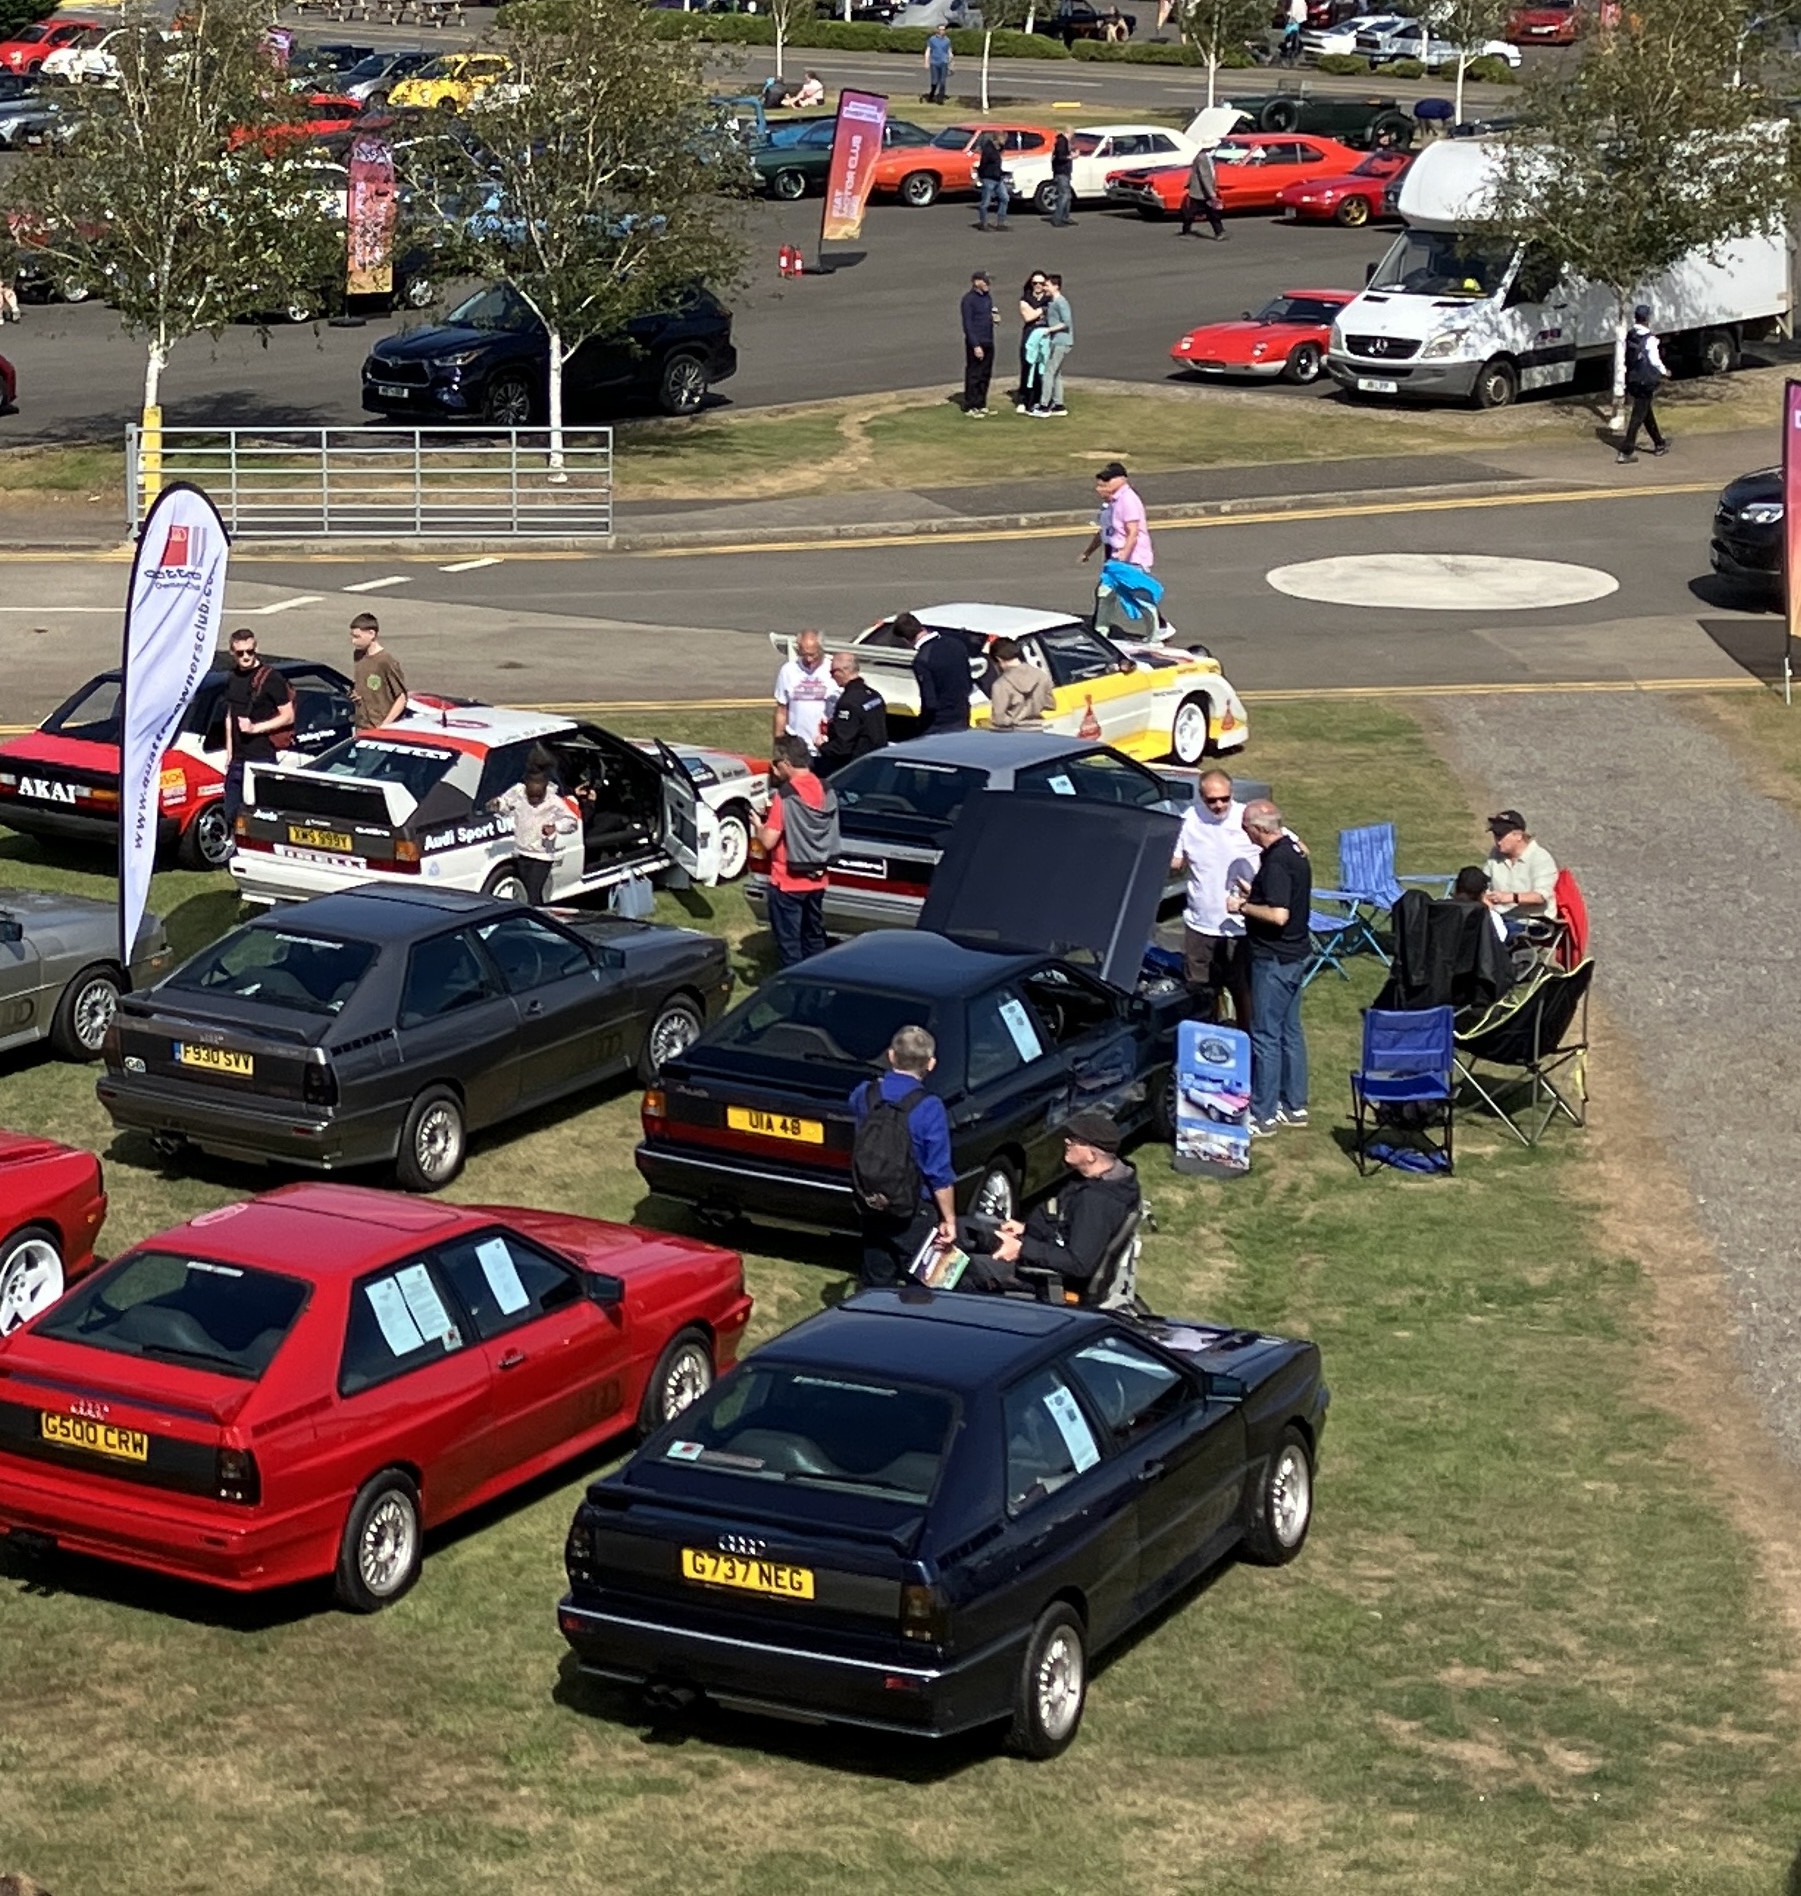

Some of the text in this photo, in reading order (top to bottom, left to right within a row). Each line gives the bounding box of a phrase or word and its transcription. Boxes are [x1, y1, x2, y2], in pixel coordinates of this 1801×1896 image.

[18, 776, 76, 804] AKAI
[424, 830, 456, 851] Audi
[458, 822, 496, 846] Sport
[184, 1044, 220, 1064] F930
[749, 1111, 774, 1132] UIA
[45, 1415, 144, 1455] G500 CRW
[692, 1553, 803, 1592] G737 NEG
